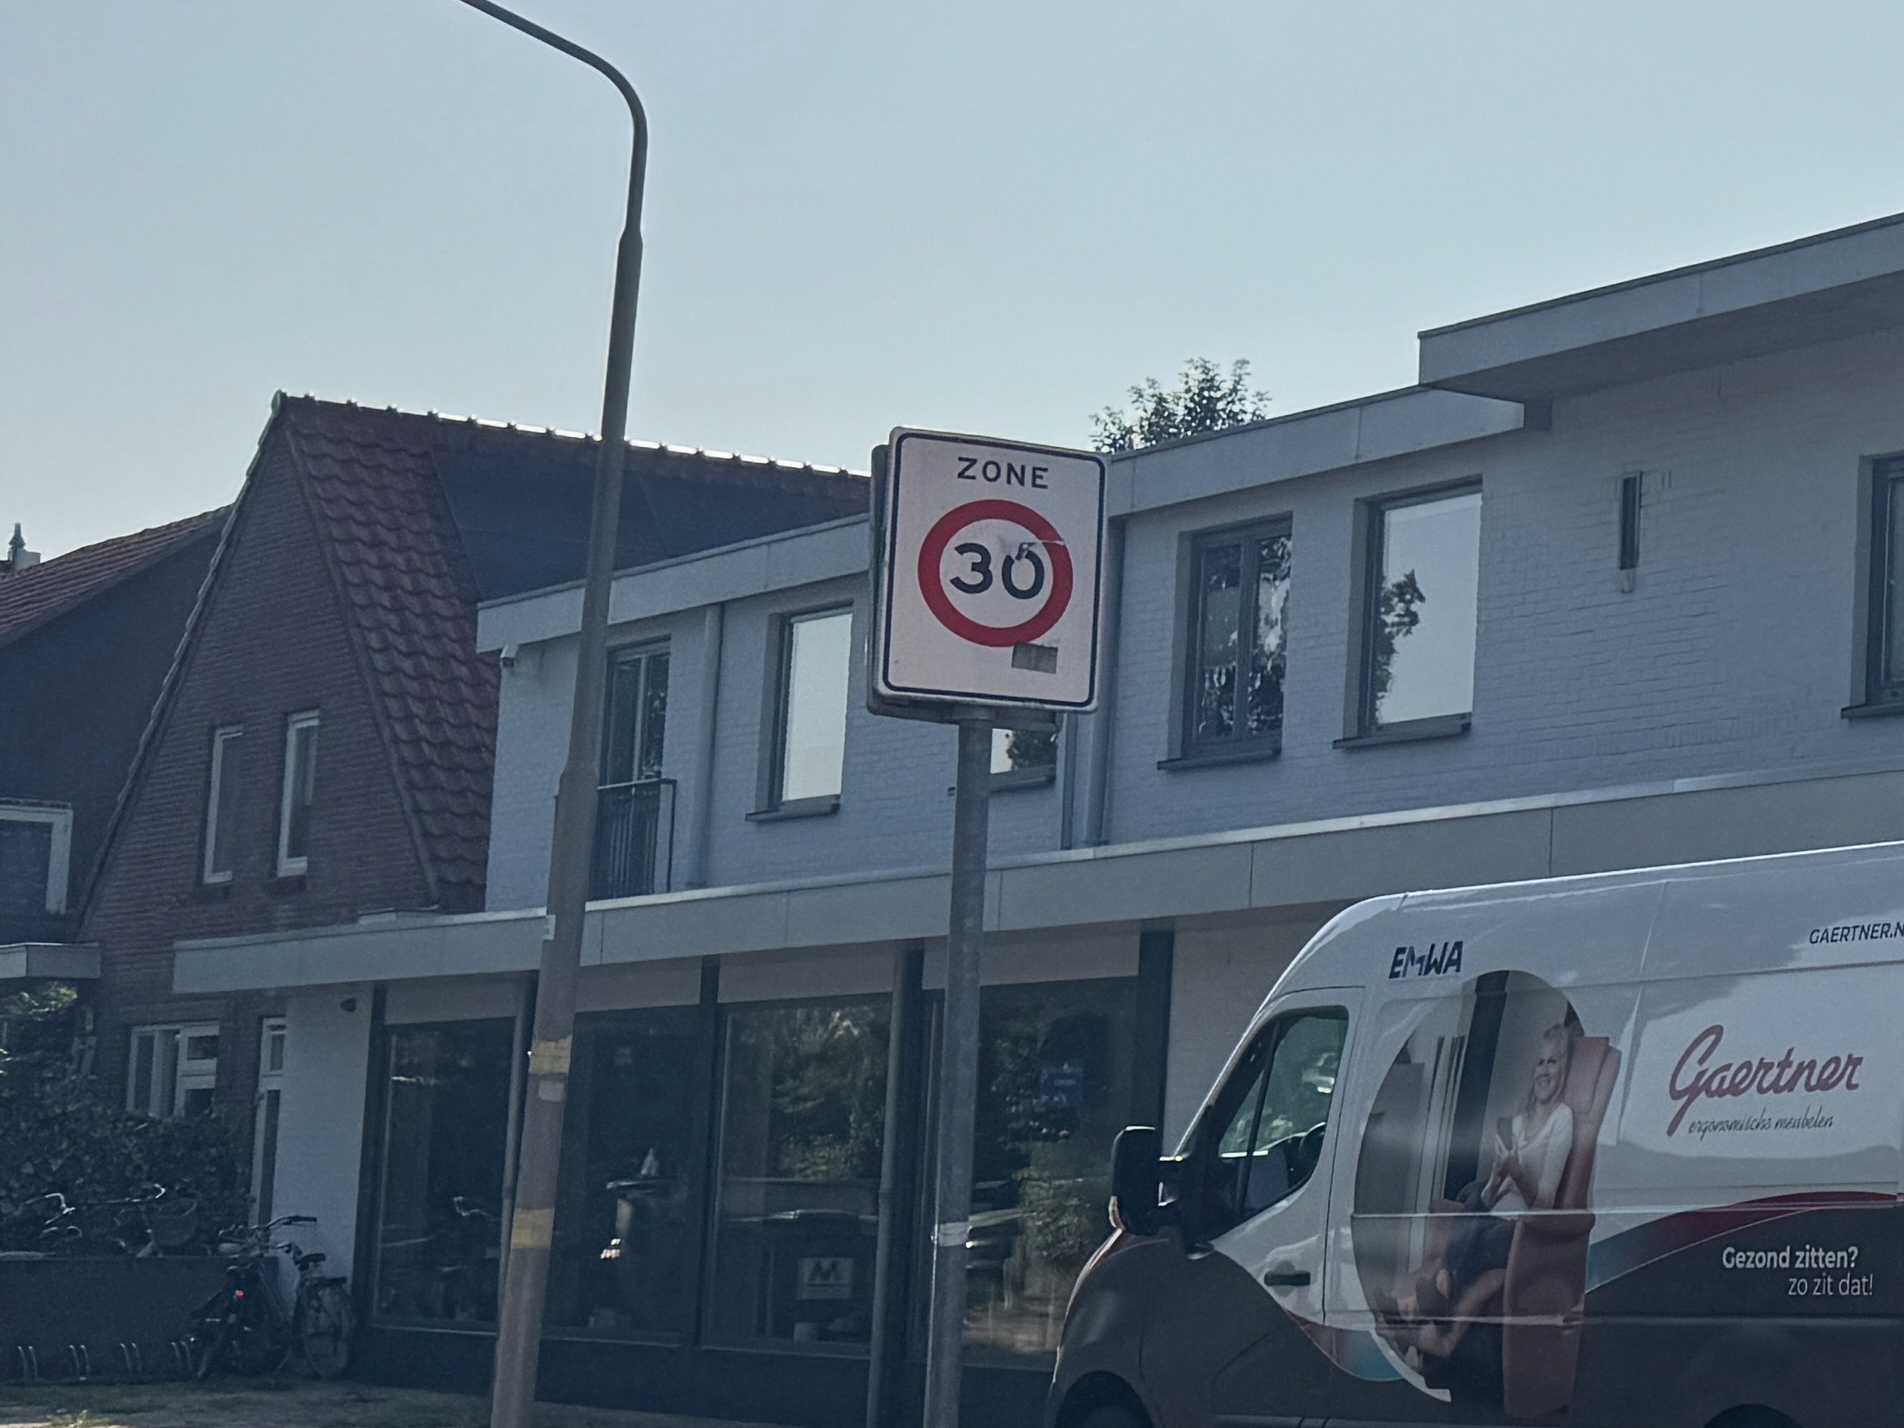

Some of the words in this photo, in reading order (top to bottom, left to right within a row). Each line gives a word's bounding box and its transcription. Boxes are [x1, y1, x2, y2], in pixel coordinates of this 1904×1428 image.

[957, 456, 1049, 489] ZONE
[949, 542, 1045, 600] 30
[1389, 940, 1463, 979] EMWA
[1666, 1024, 1864, 1137] Gaertner
[1688, 1106, 1771, 1141] ergonomische
[1774, 1104, 1833, 1131] meubelen
[1722, 1245, 1791, 1269] Gezond
[1794, 1244, 1859, 1269] zitten?
[1788, 1277, 1808, 1296] zo
[1812, 1272, 1834, 1296] zit
[1838, 1272, 1873, 1296] dat!
